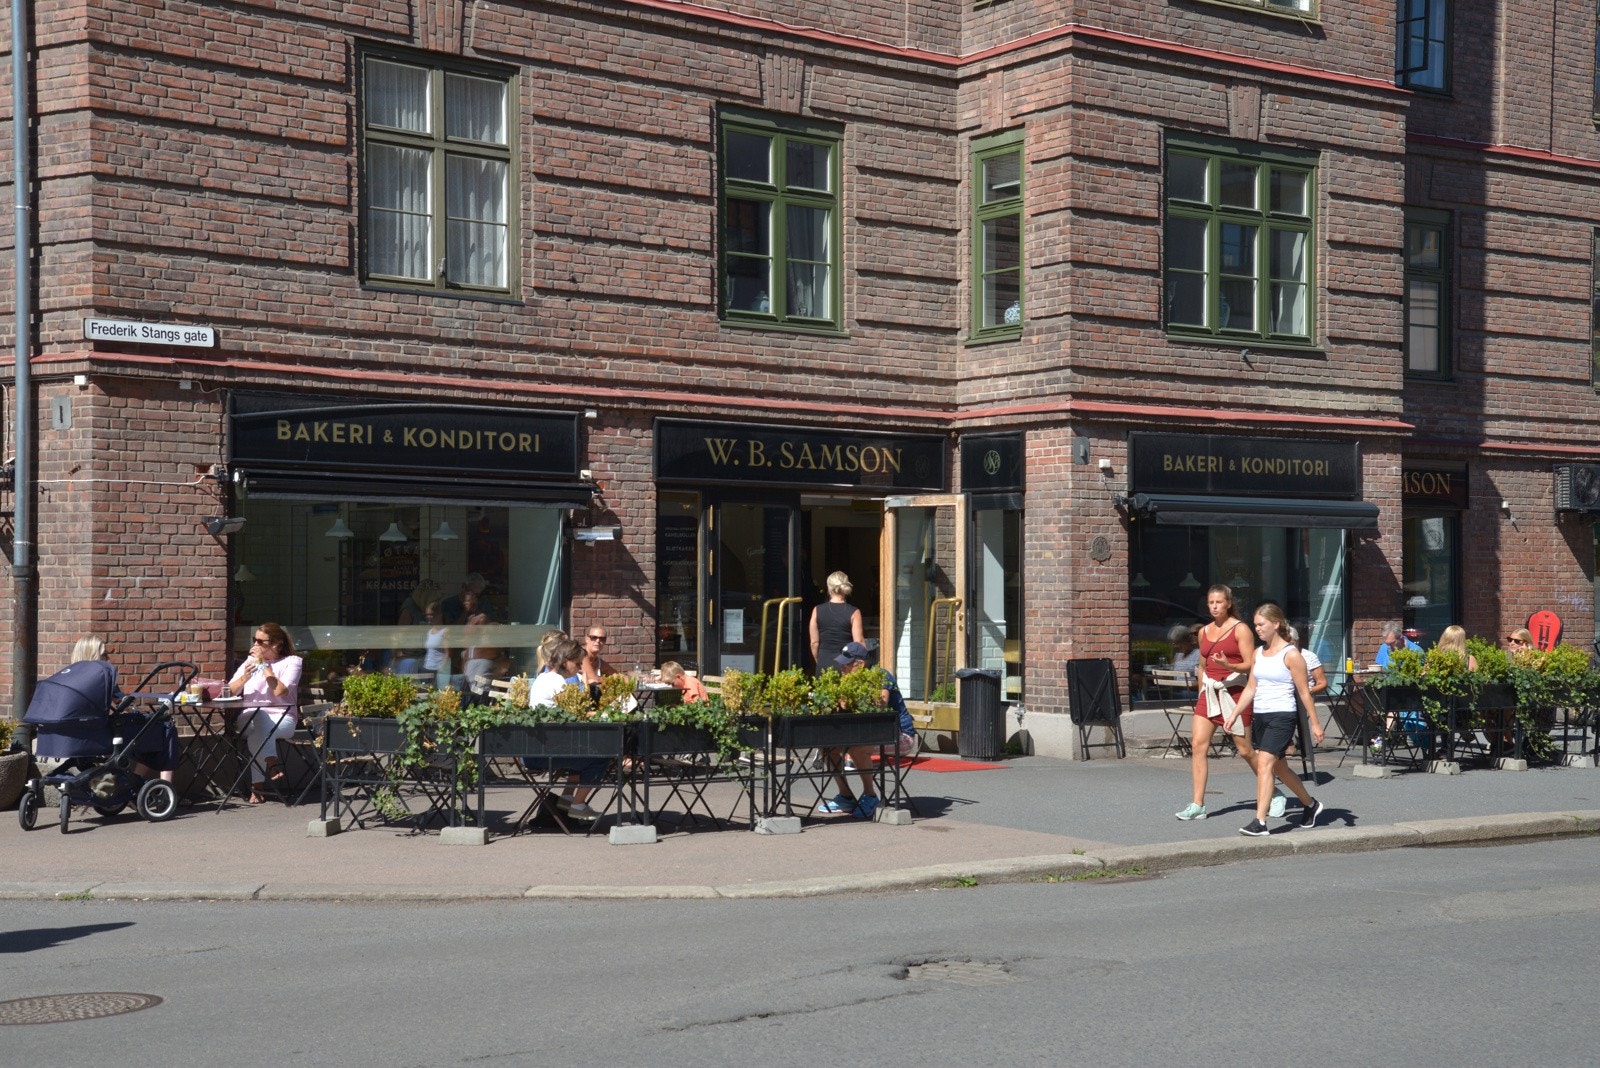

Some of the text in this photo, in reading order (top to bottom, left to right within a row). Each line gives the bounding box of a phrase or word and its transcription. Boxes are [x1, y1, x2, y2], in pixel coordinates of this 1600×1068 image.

[91, 322, 208, 344] Frederik Stangs gate
[277, 420, 540, 453] BAKERI & KONDITORI
[703, 437, 740, 467] W.
[748, 440, 773, 468] B.
[780, 441, 903, 474] SAMSON
[1163, 454, 1329, 476] BAKERI & KONDITORI
